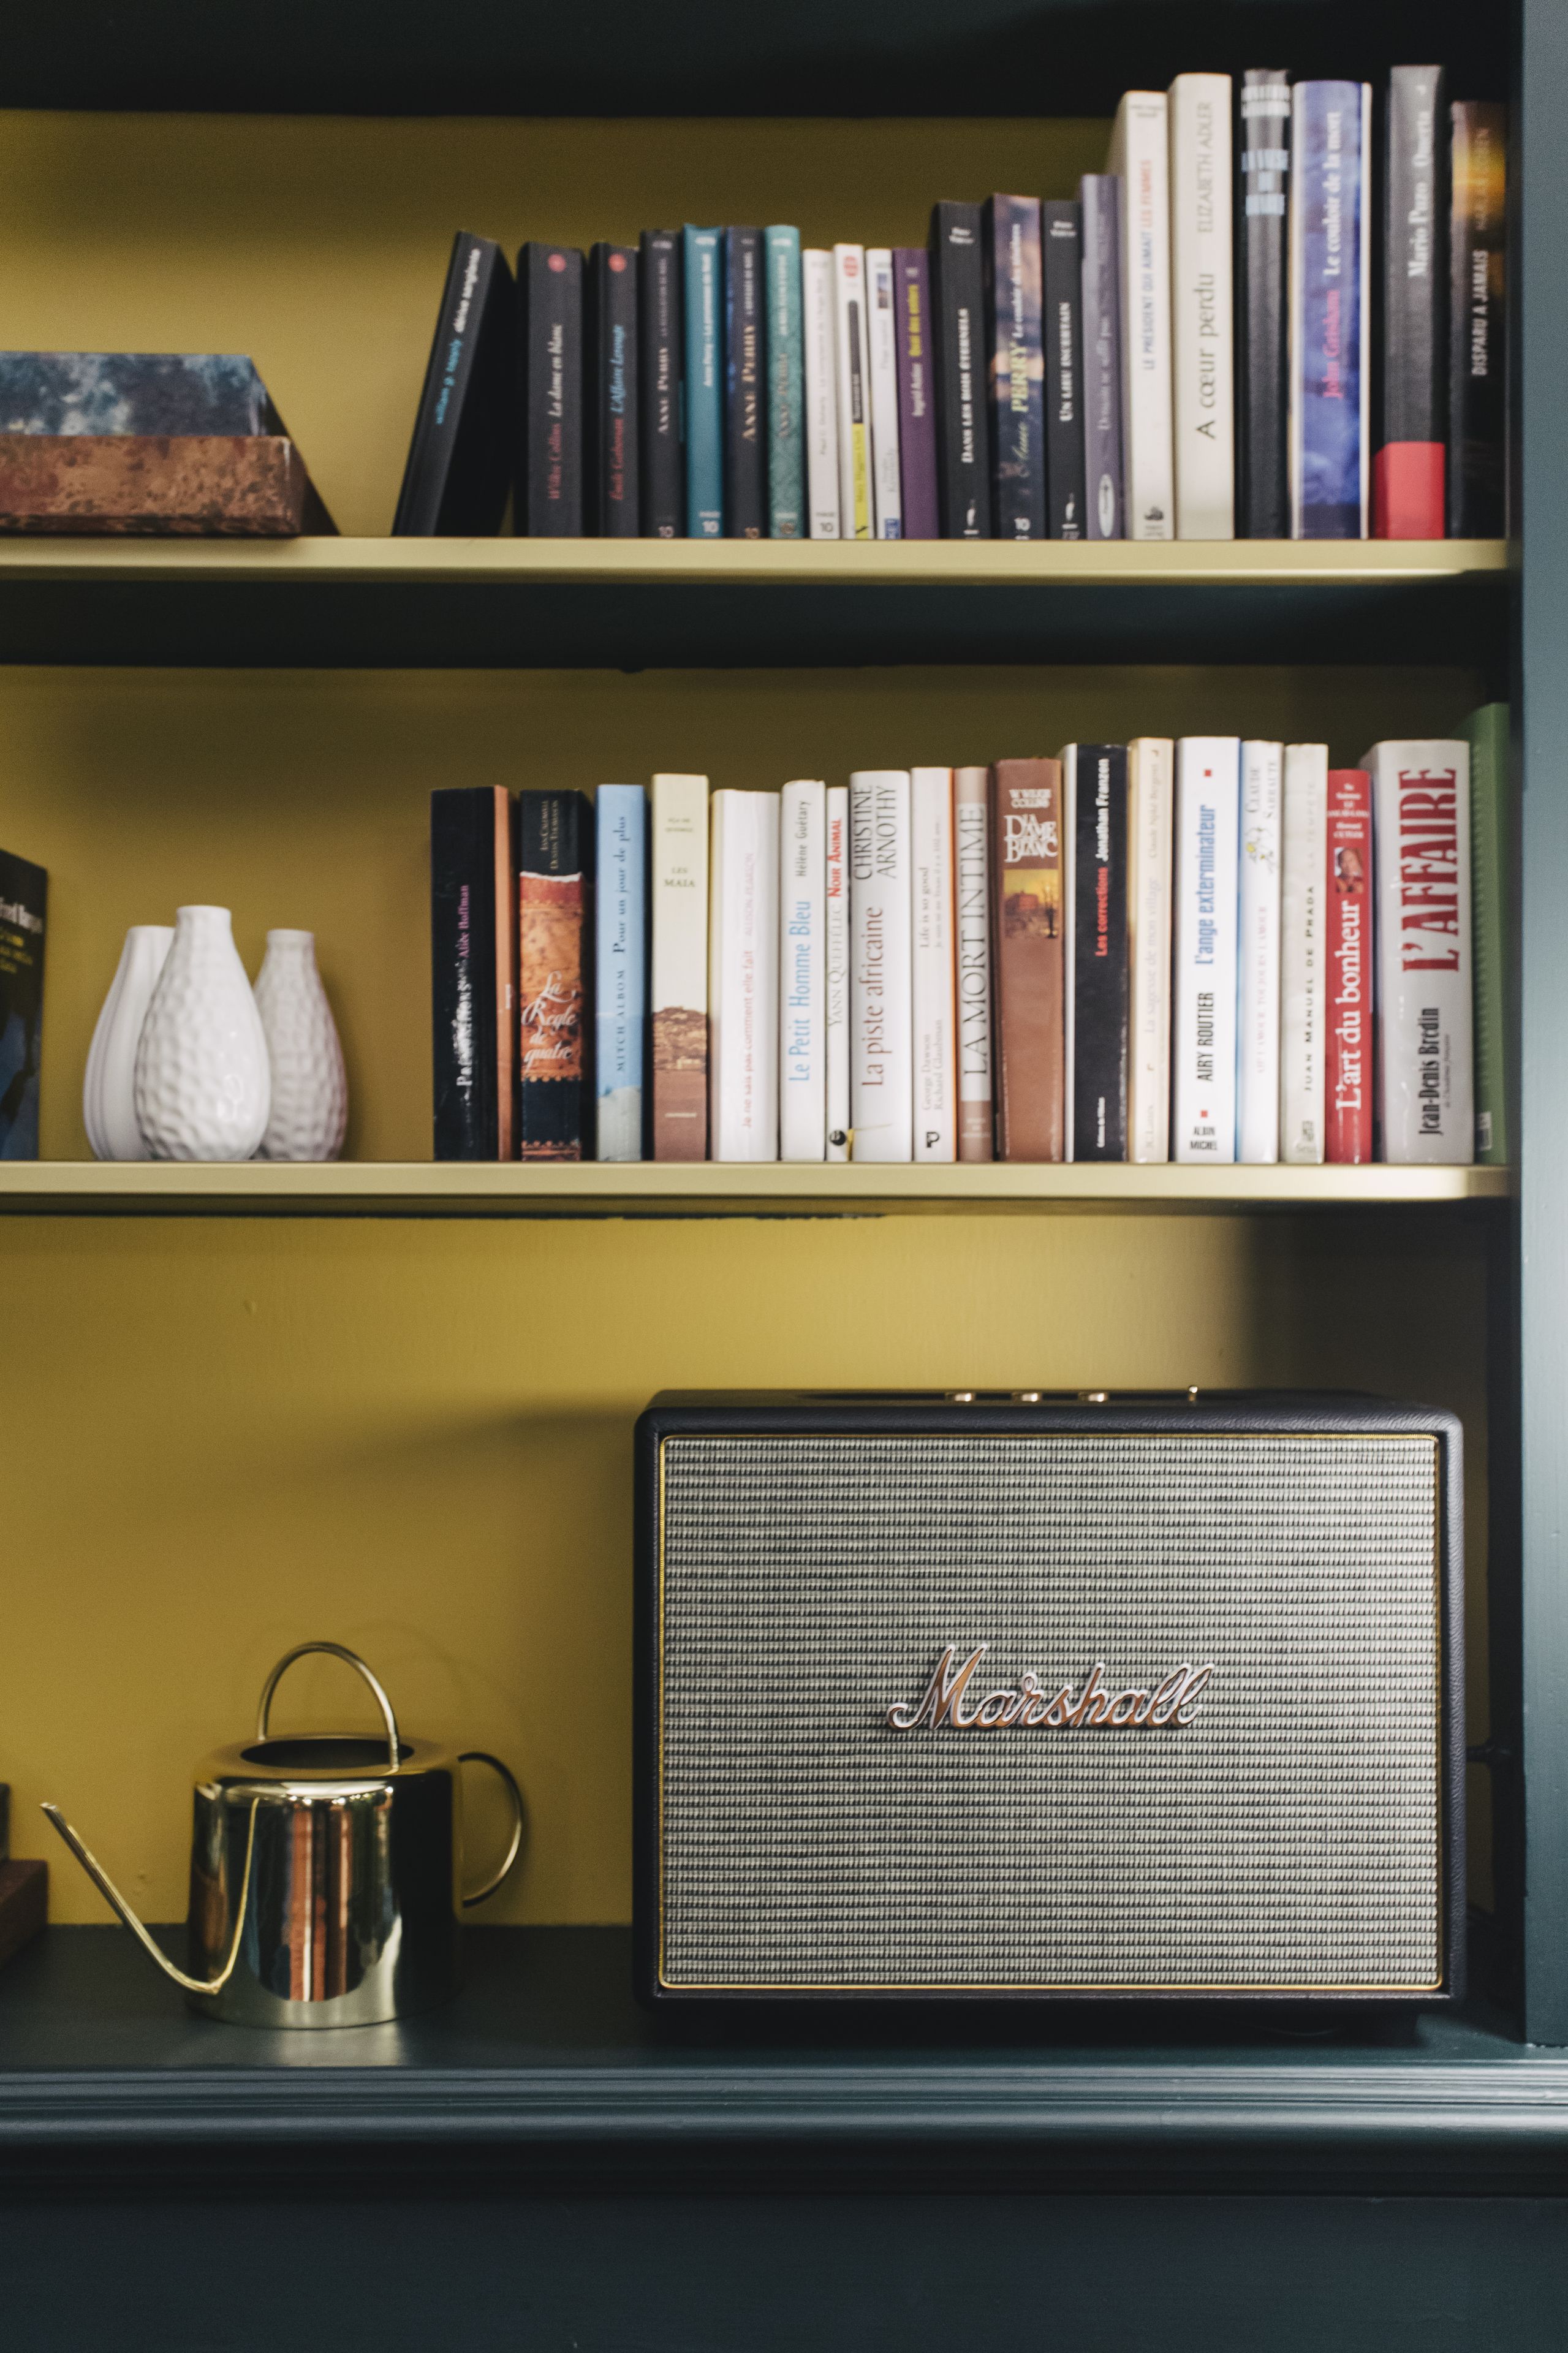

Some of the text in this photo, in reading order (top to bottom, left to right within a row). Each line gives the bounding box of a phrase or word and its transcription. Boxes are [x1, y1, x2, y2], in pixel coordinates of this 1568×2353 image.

[1138, 159, 1153, 207] FEMMES
[1196, 101, 1214, 233] ELIZABETH ADLER
[1321, 111, 1341, 275] Le couloir de la mort
[1139, 210, 1153, 227] LES
[1407, 182, 1429, 278] Mario Puzo
[1140, 273, 1153, 292] QUI
[1140, 296, 1155, 354] PRÉSIDENT
[1471, 249, 1489, 376] DISPARU A JAMAIS
[547, 371, 562, 400] dame
[552, 356, 562, 369] en
[1010, 341, 1029, 412] PERRY
[1140, 358, 1155, 370] LE
[1192, 274, 1221, 439] A cœur perdu
[1321, 290, 1343, 398] John Grisham
[547, 402, 562, 417] La
[853, 785, 873, 881] CHRISTINE
[876, 786, 897, 879] ARNOTHY
[1095, 759, 1110, 862] Jonathan Franzen
[1244, 767, 1260, 813] CLAUDE
[793, 800, 812, 876] Hélène Guétary
[827, 819, 843, 898] NOIR ANIMAL
[1194, 804, 1216, 914] exterminateur
[1398, 768, 1460, 972] L'AFFAIRE
[457, 885, 469, 930] Hoffman
[612, 816, 631, 954] Pour un jour de plus
[917, 867, 931, 948] Life is so good
[1094, 867, 1108, 957] Les corrections
[960, 807, 988, 1075] LA MORT INTIME
[616, 970, 626, 1072] MITCH ALBOM
[788, 901, 811, 1081] Le Petit Homme Bleu
[827, 990, 843, 1028] YANN
[858, 906, 893, 1086] La piste africaine
[1303, 886, 1314, 1092] JUAN MANUEL DE PRADA
[1333, 900, 1362, 1110] L'art du bonheur
[741, 951, 755, 1128] Je ne sais pas comment elle fait
[920, 1034, 932, 1111] George Dawson
[933, 1020, 944, 1111] Richard Glaubman
[1197, 993, 1213, 1082] AIRY ROUTIER
[1417, 1008, 1444, 1136] Jean-Denis Bredin
[887, 1643, 1215, 1729] Marshall
